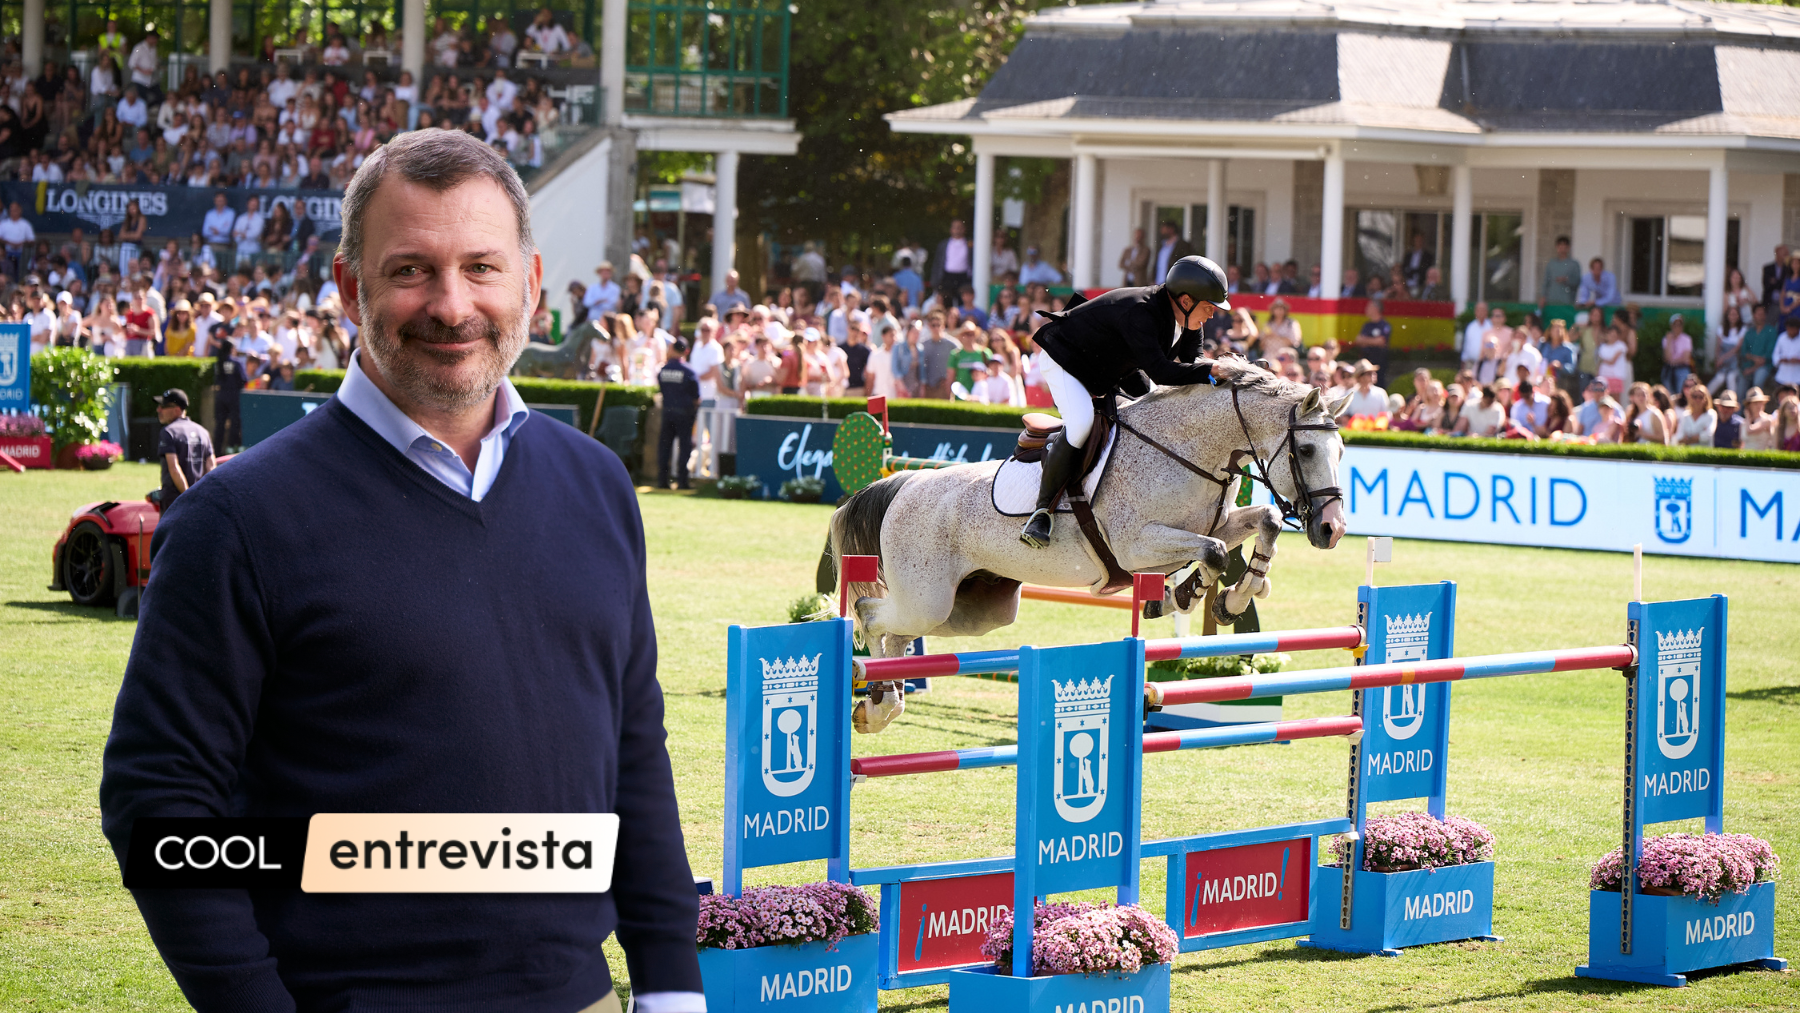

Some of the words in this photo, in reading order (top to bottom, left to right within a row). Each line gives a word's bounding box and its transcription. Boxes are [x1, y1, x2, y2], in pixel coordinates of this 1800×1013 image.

[1350, 466, 1588, 527] MADRID
[1740, 488, 1800, 541] M
[1367, 749, 1433, 776] MADRID
[1644, 768, 1710, 798] MADRID
[744, 805, 830, 839] MADRID
[1038, 831, 1123, 865] MADRID
[1404, 889, 1474, 920] MADRID
[1685, 911, 1756, 945] MADRID
[760, 964, 852, 1002] MADRID
